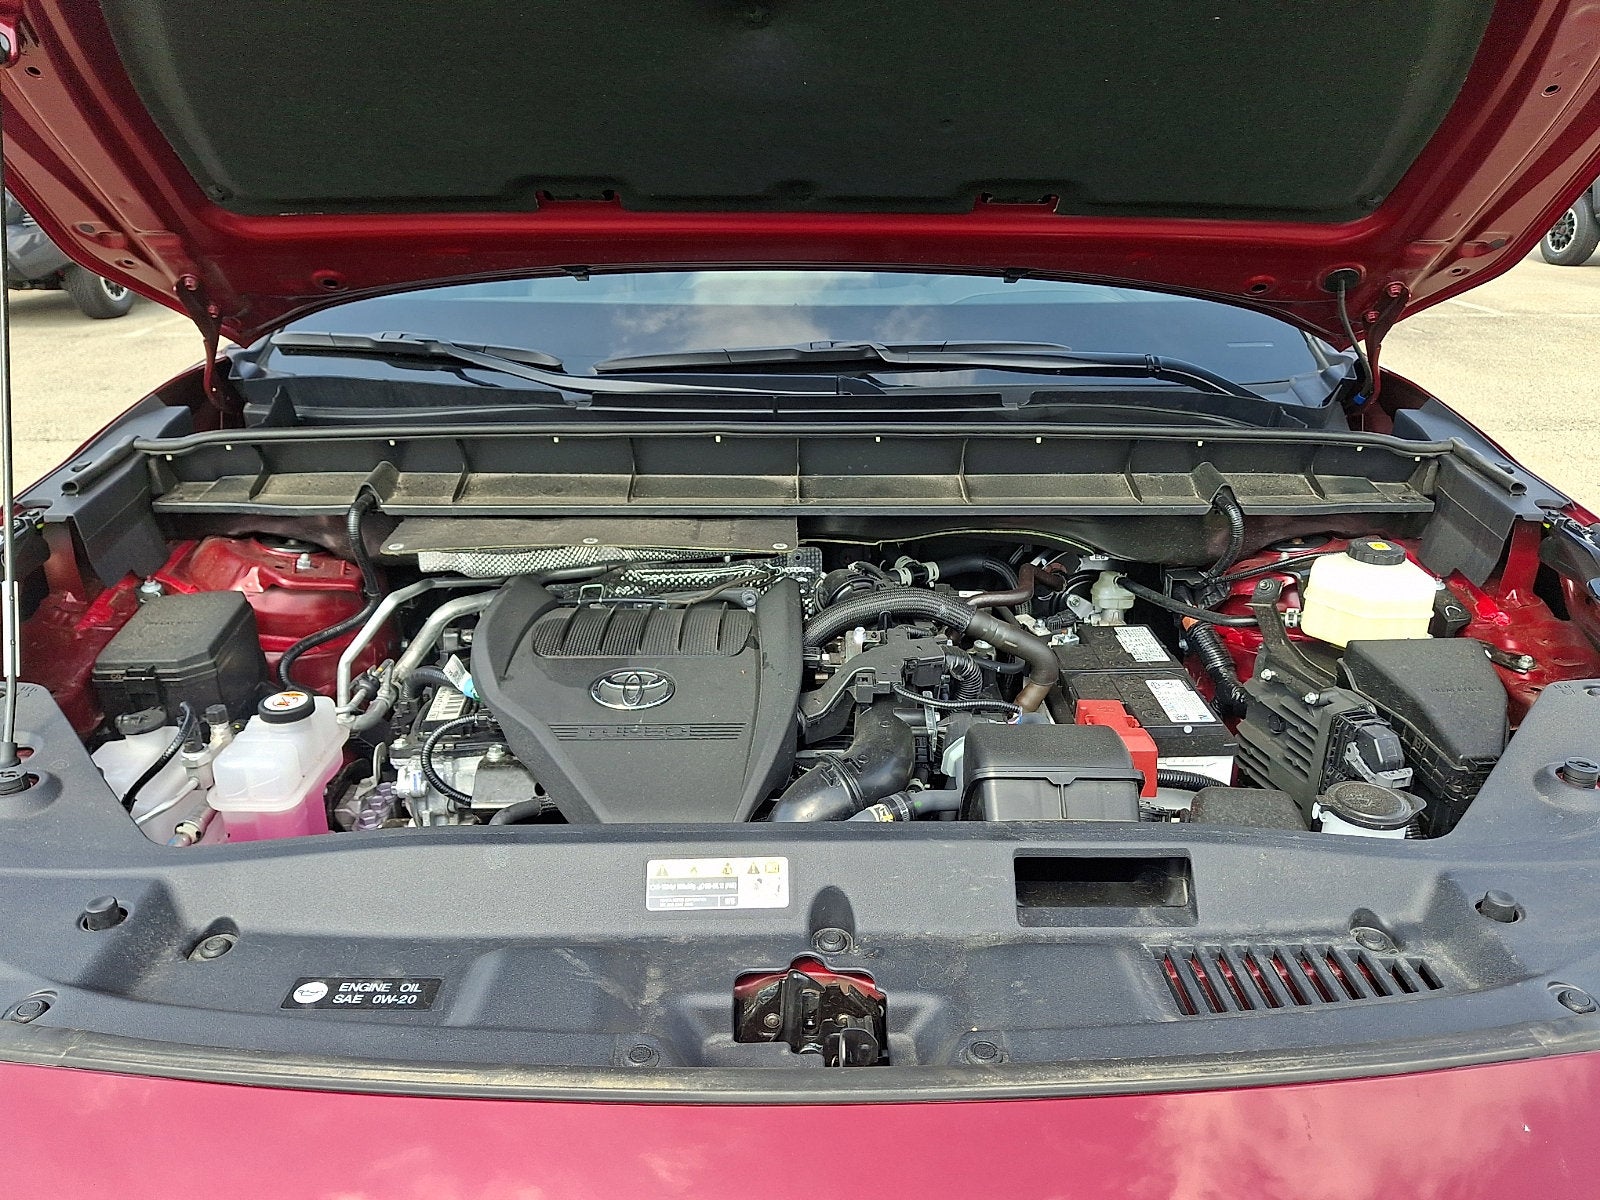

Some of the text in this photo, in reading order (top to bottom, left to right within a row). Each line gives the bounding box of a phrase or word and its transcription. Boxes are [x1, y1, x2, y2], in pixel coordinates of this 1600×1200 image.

[339, 982, 422, 992] ENGINE OIL
[332, 994, 418, 1004] SAE 0W-20
